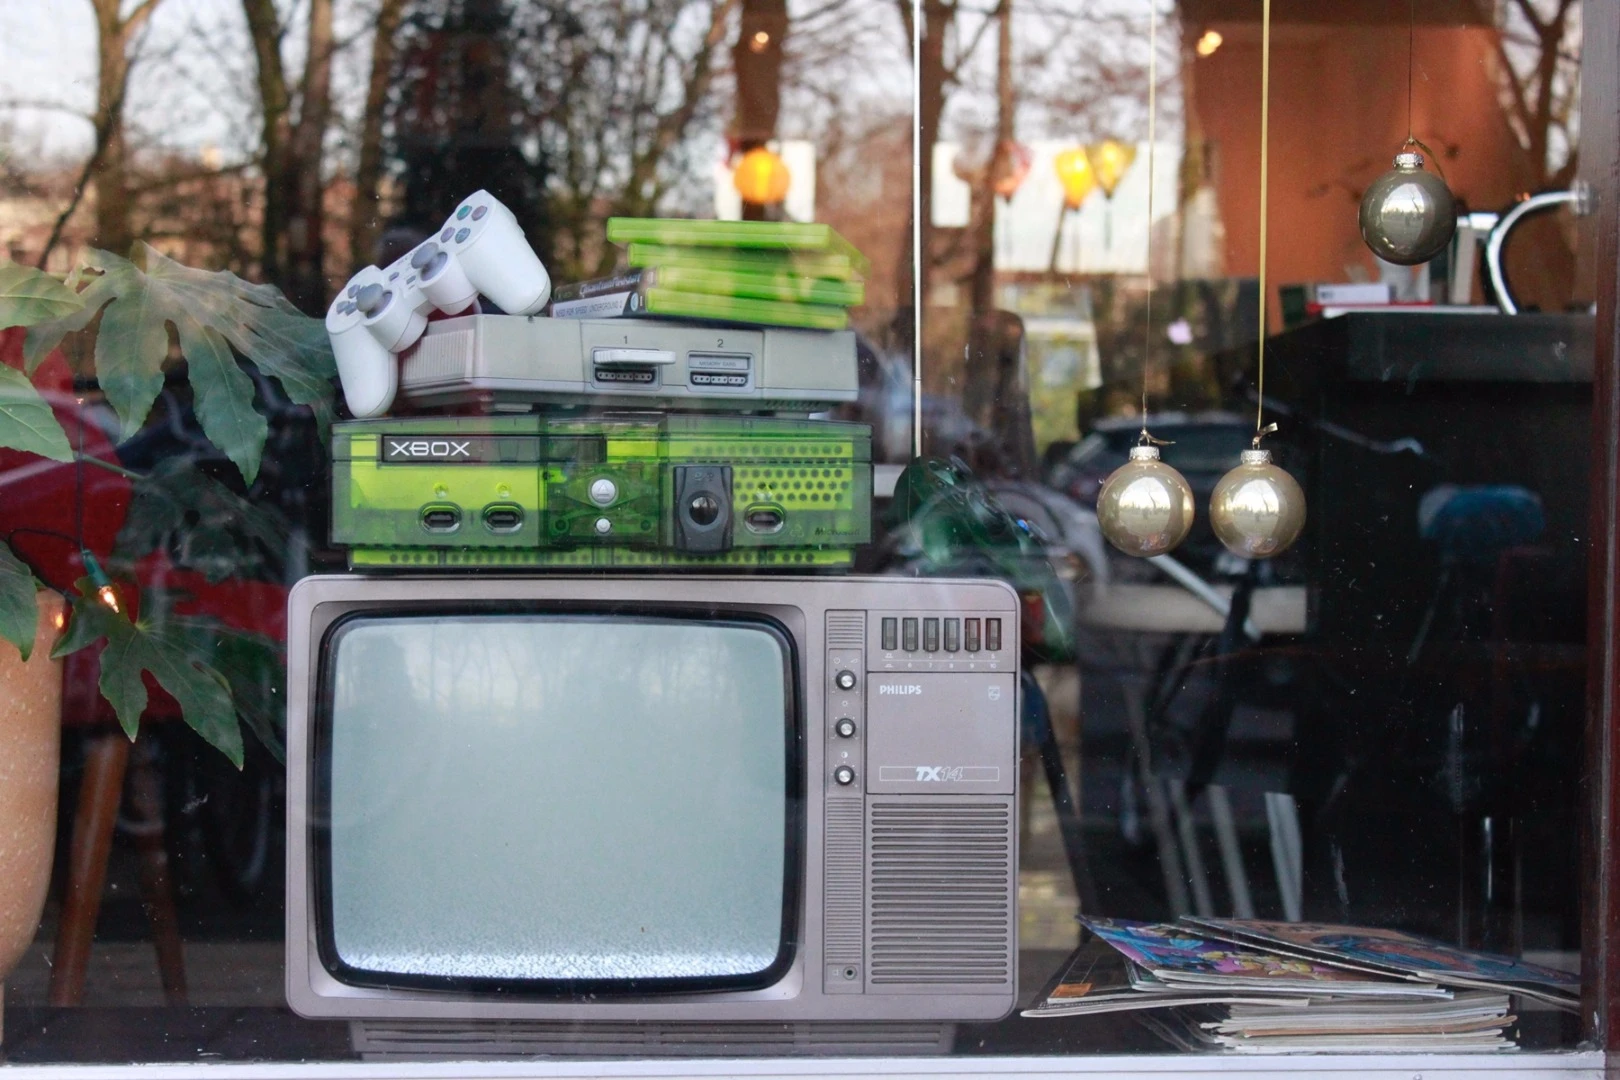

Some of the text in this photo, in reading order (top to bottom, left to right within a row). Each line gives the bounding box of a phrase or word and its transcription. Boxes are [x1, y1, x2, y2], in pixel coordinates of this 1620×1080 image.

[623, 335, 628, 344] 1
[717, 338, 724, 348] 2
[390, 441, 470, 456] XBOX
[880, 685, 922, 695] PHILIPS
[916, 766, 963, 781] TX14
